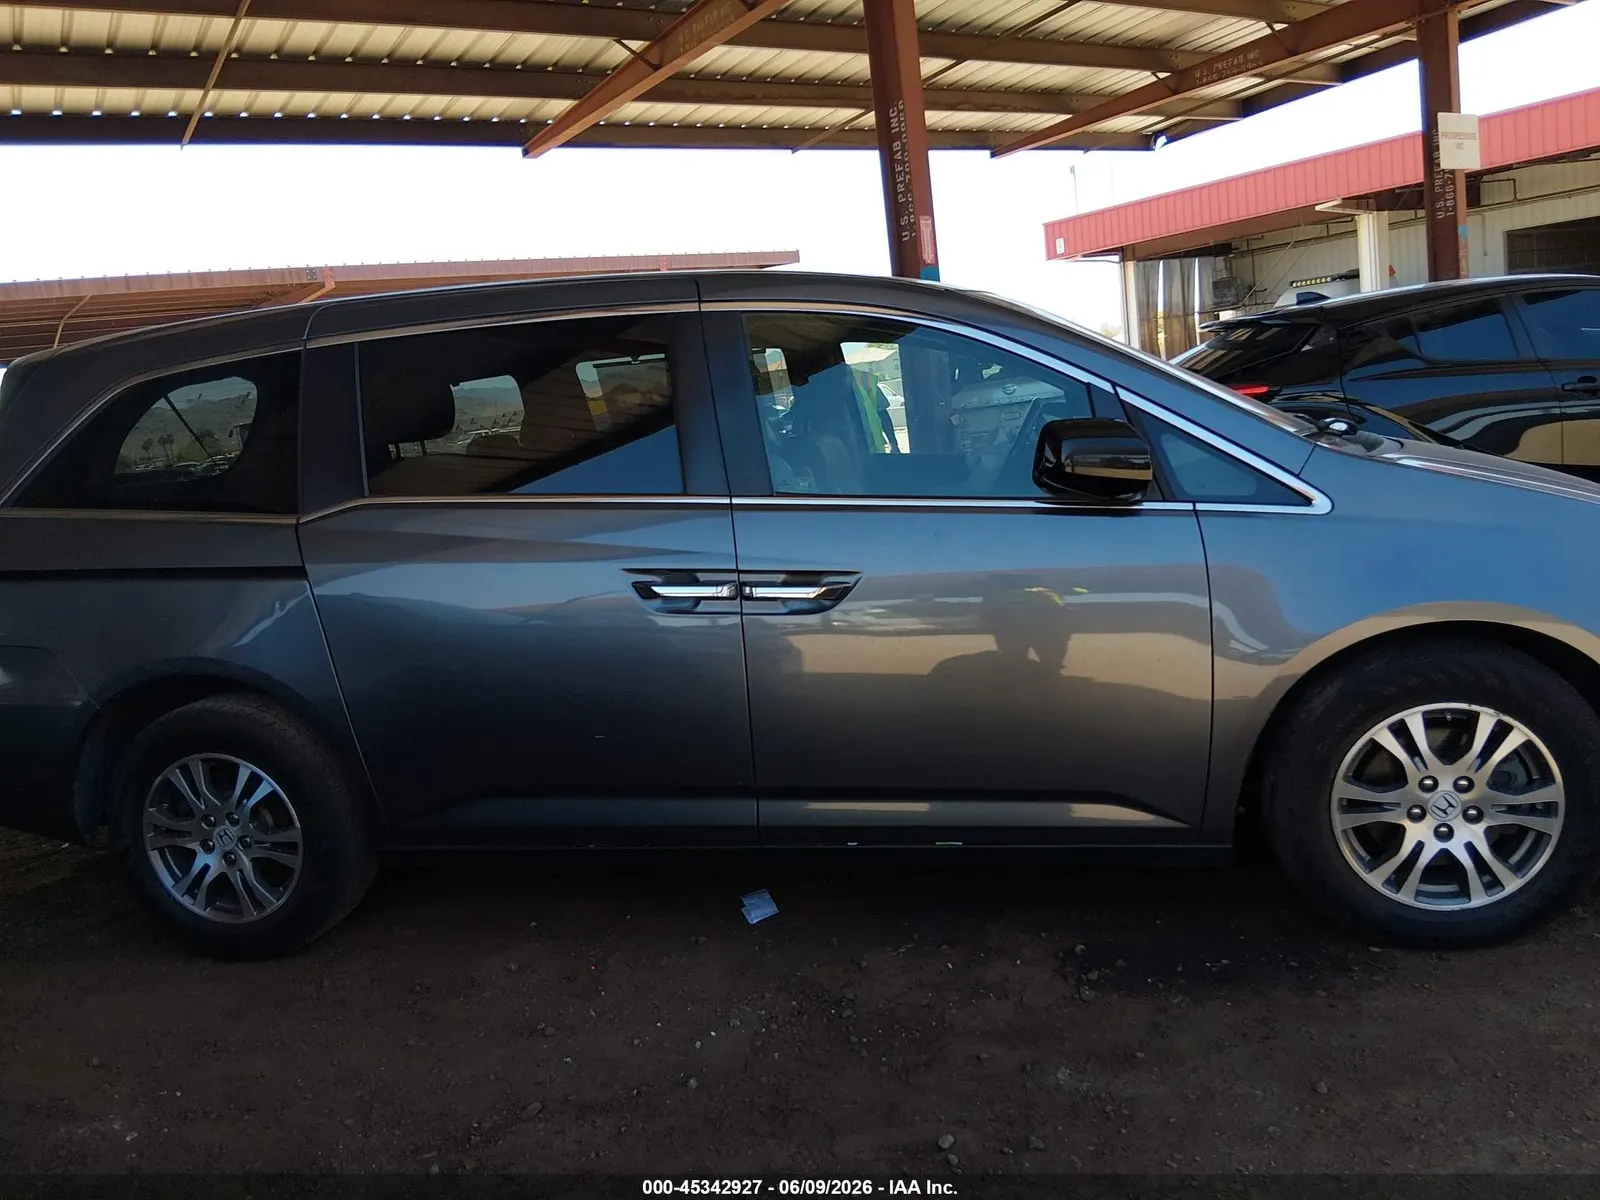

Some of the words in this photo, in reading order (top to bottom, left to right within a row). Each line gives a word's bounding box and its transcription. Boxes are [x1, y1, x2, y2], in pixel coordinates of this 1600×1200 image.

[1213, 54, 1244, 72] PREFAB
[893, 140, 907, 203] PREFAB
[1435, 198, 1446, 219] U.S.
[900, 211, 911, 242] U.S.
